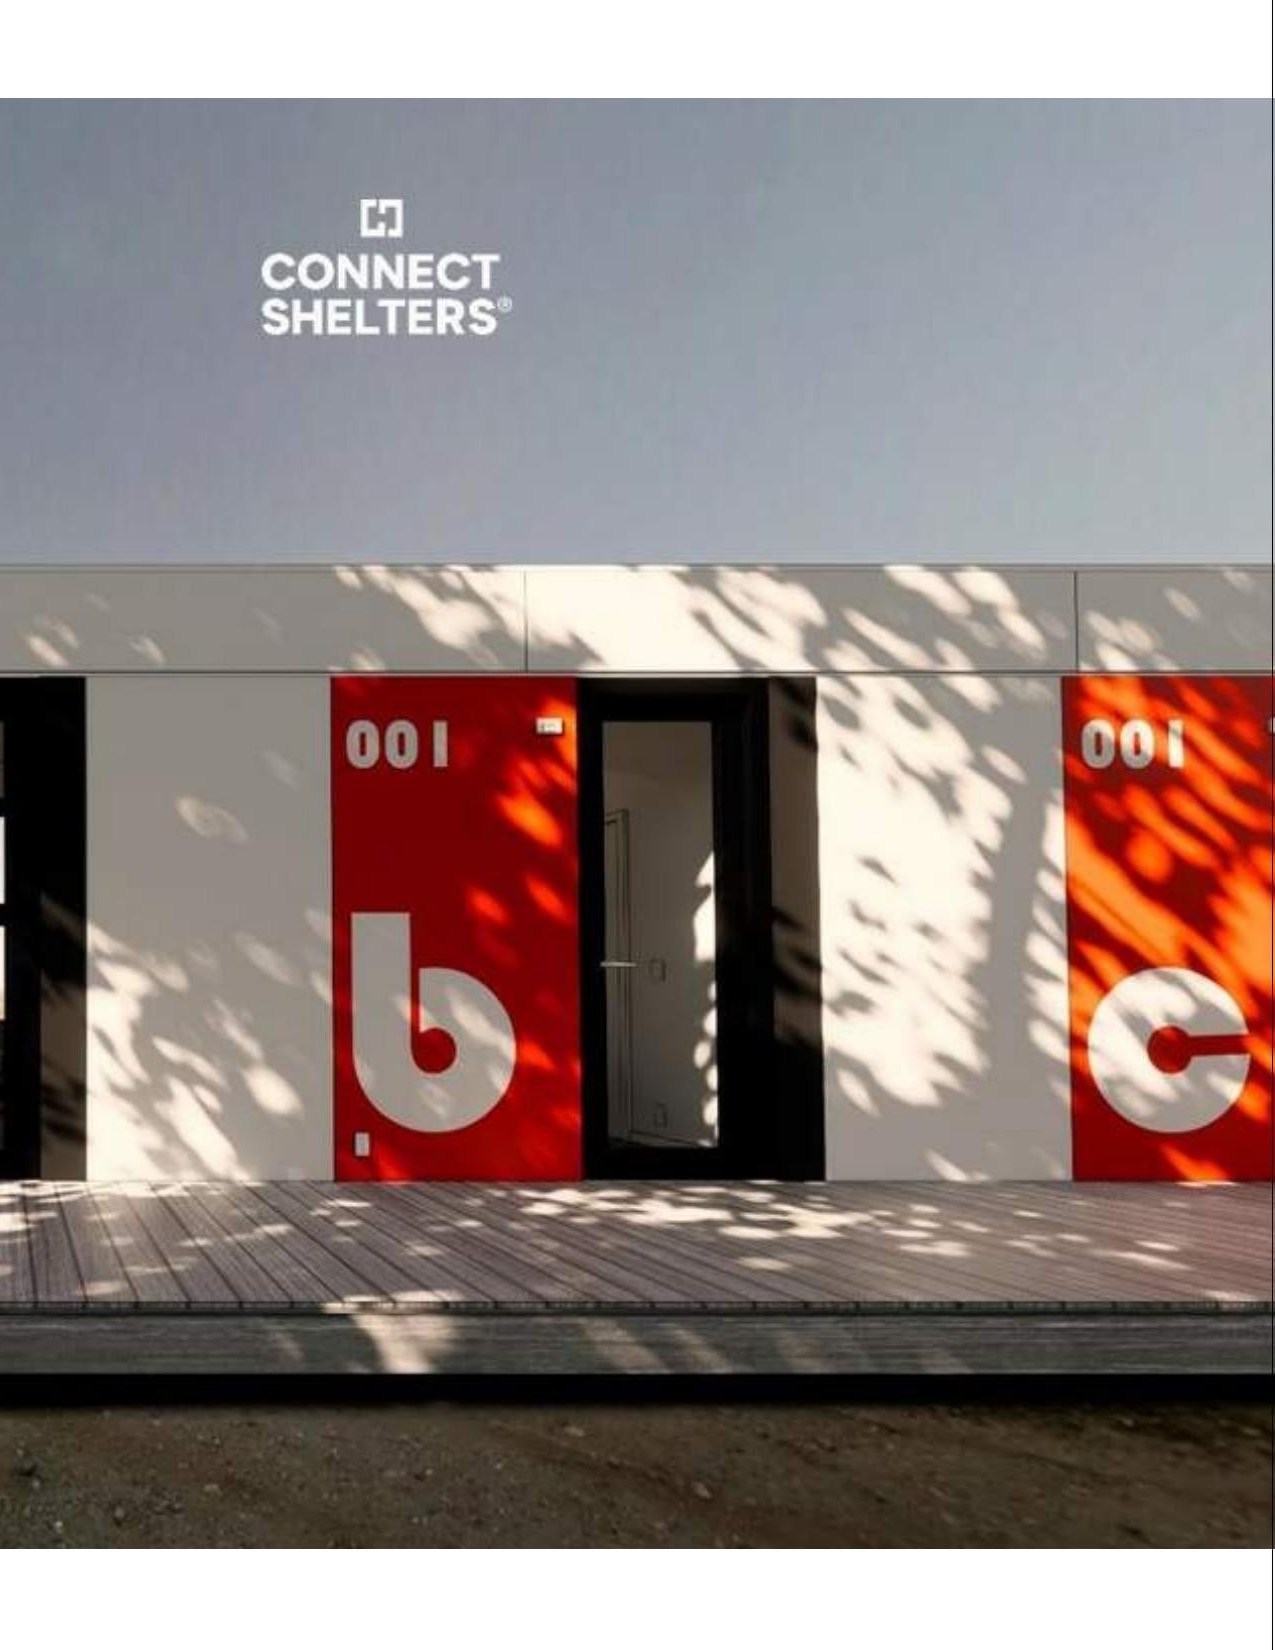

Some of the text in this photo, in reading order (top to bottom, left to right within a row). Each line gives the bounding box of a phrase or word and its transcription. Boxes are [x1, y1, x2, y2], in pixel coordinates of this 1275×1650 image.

[346, 719, 448, 769] 001
[1081, 719, 1184, 769] 001
[350, 911, 517, 1133] b
[1087, 966, 1252, 1134] c
